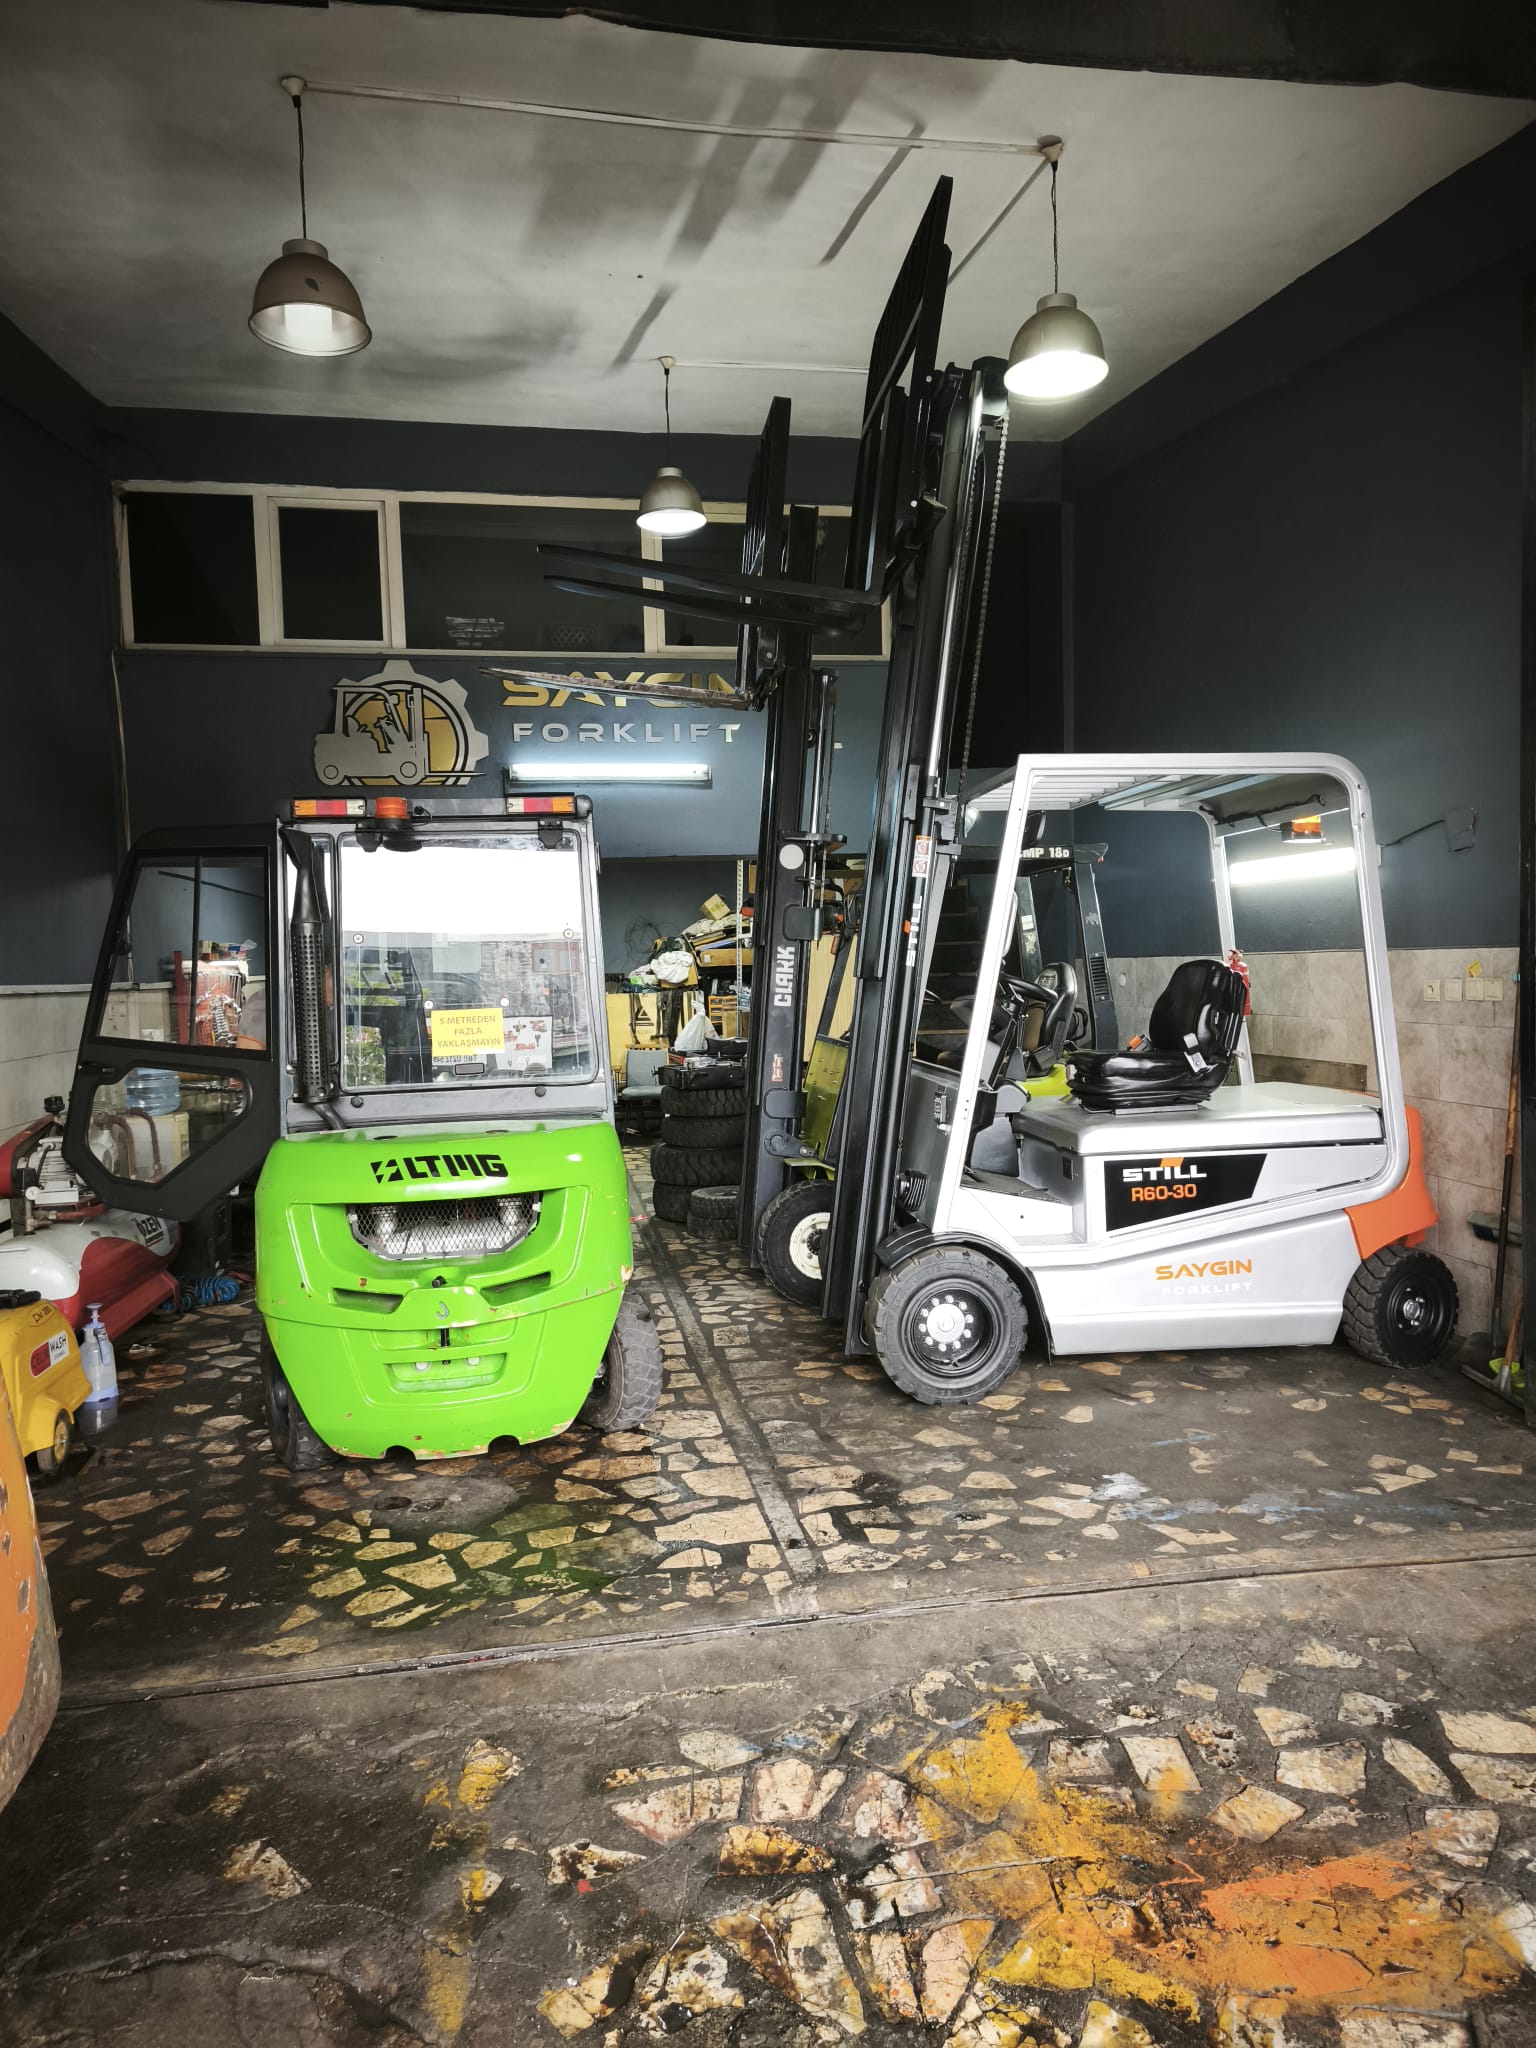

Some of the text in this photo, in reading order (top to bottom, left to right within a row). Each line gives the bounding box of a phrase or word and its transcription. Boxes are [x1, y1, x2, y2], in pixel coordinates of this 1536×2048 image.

[513, 723, 741, 743] FORKLIFT
[906, 896, 923, 968] STILL
[773, 946, 796, 1007] CLARK
[447, 1015, 496, 1025] METREDEN
[454, 1027, 482, 1036] FAZLA
[1122, 1165, 1207, 1182] STILL
[1131, 1183, 1197, 1202] R60-30
[1155, 1259, 1252, 1281] SAYGIN
[1161, 1282, 1253, 1296] FORKLIFT
[49, 1334, 67, 1352] WASH
